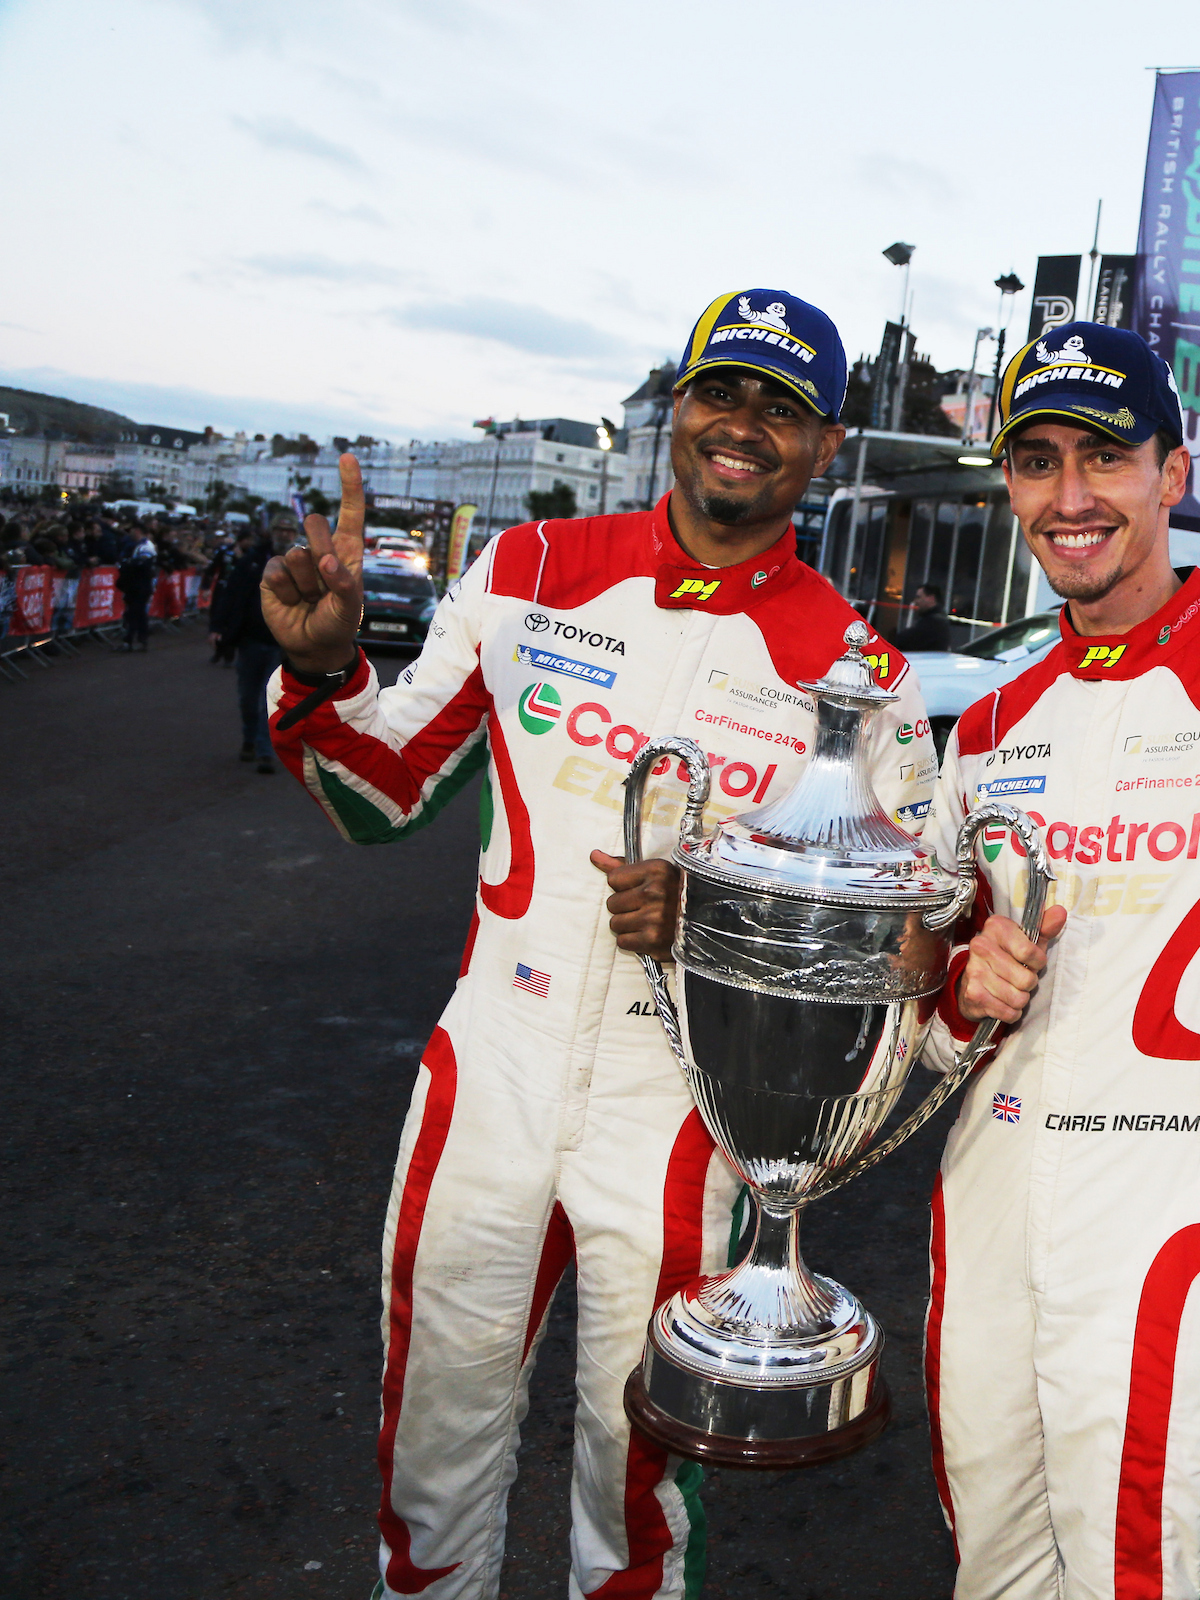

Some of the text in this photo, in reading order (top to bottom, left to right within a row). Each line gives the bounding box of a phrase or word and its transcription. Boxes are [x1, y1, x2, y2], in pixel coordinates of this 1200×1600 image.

[1148, 96, 1185, 357] BRITISH RALLY CHA
[710, 327, 815, 364] MICHELIN
[1015, 366, 1125, 399] MICHELIN
[668, 578, 722, 601] P1
[553, 621, 625, 656] TOYOTA
[535, 653, 611, 683] MICHELIN
[1077, 643, 1129, 668] P1
[729, 688, 778, 709] ASSURANCES
[695, 709, 798, 748] CarFinance 247
[1144, 744, 1194, 754] ASSURANCES
[989, 778, 1044, 793] MICHELIN
[1115, 776, 1193, 792] CarFinance
[1045, 1113, 1200, 1132] CHRIS INGRAM
